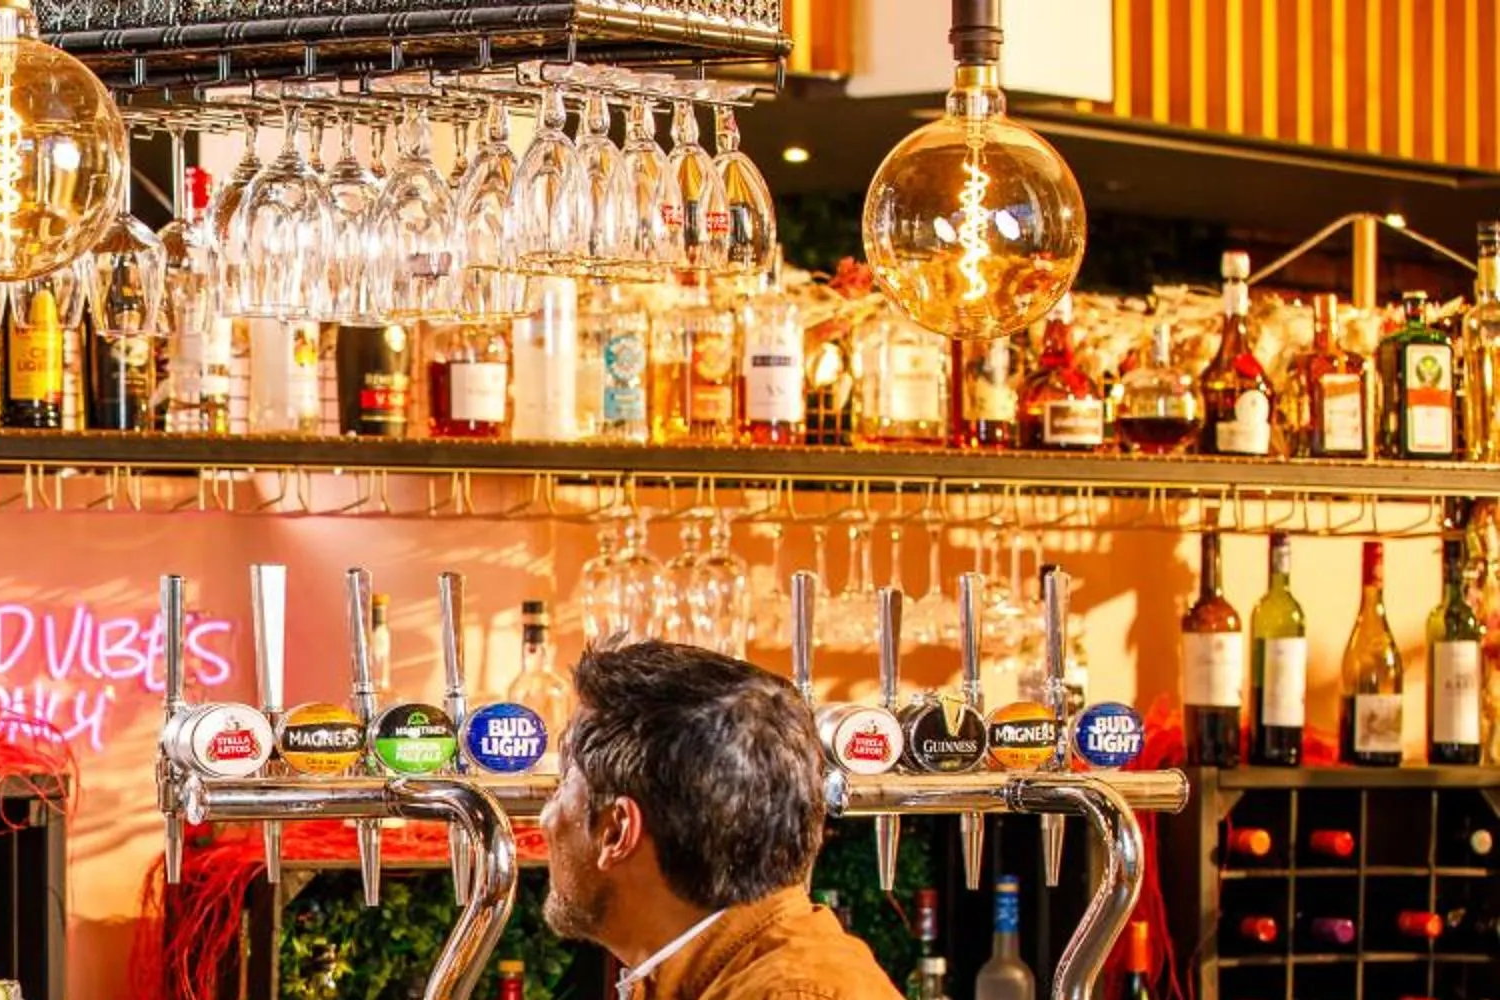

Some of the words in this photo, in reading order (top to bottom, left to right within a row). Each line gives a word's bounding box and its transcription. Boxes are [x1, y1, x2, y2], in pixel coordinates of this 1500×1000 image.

[43, 602, 232, 692] VIBES
[487, 718, 536, 737] BUD
[1095, 715, 1135, 733] BUD
[217, 736, 250, 746] STELLA
[288, 727, 359, 748] MAGNERS
[480, 736, 540, 757] LIGHT
[922, 739, 978, 754] GUINNESS
[1087, 733, 1141, 753] LIGHT
